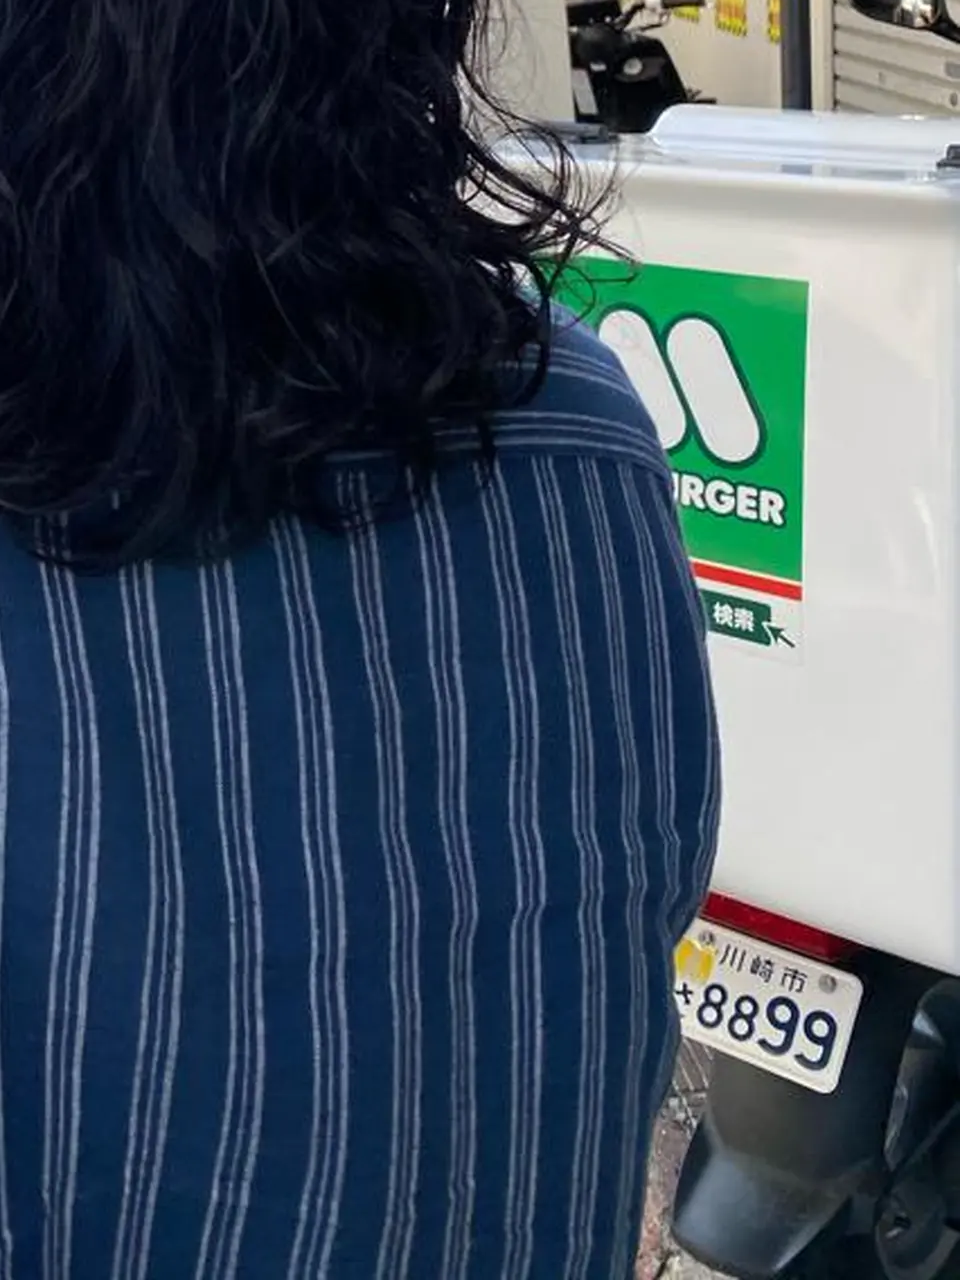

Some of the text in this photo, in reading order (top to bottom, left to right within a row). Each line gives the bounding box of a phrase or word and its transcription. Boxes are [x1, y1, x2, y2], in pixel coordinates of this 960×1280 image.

[713, 601, 754, 632] 検索
[719, 944, 808, 993] 川崎市
[696, 983, 837, 1071] 8899
